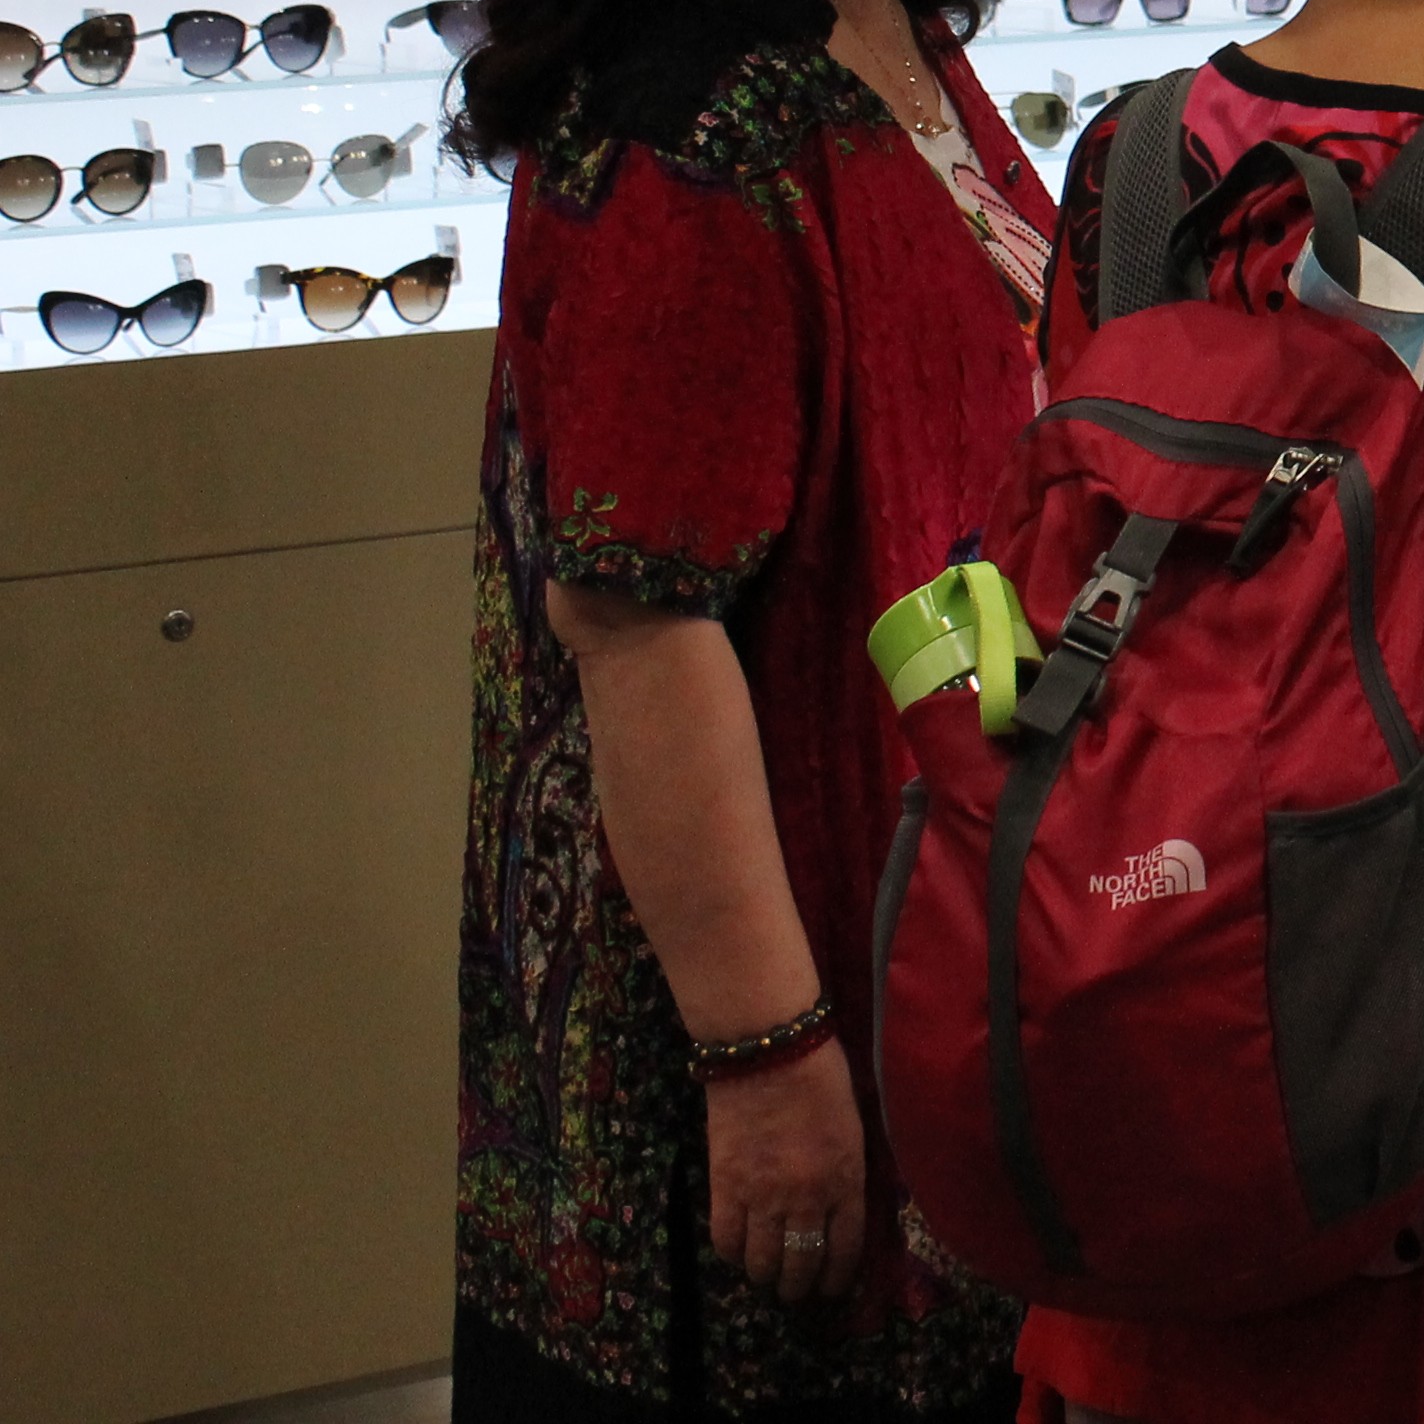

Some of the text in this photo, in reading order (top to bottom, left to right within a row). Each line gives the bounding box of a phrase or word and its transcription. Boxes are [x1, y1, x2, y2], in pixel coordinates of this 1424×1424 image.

[1124, 844, 1164, 874] THE
[1089, 861, 1164, 894] NORTH
[1111, 879, 1167, 912] FACE
